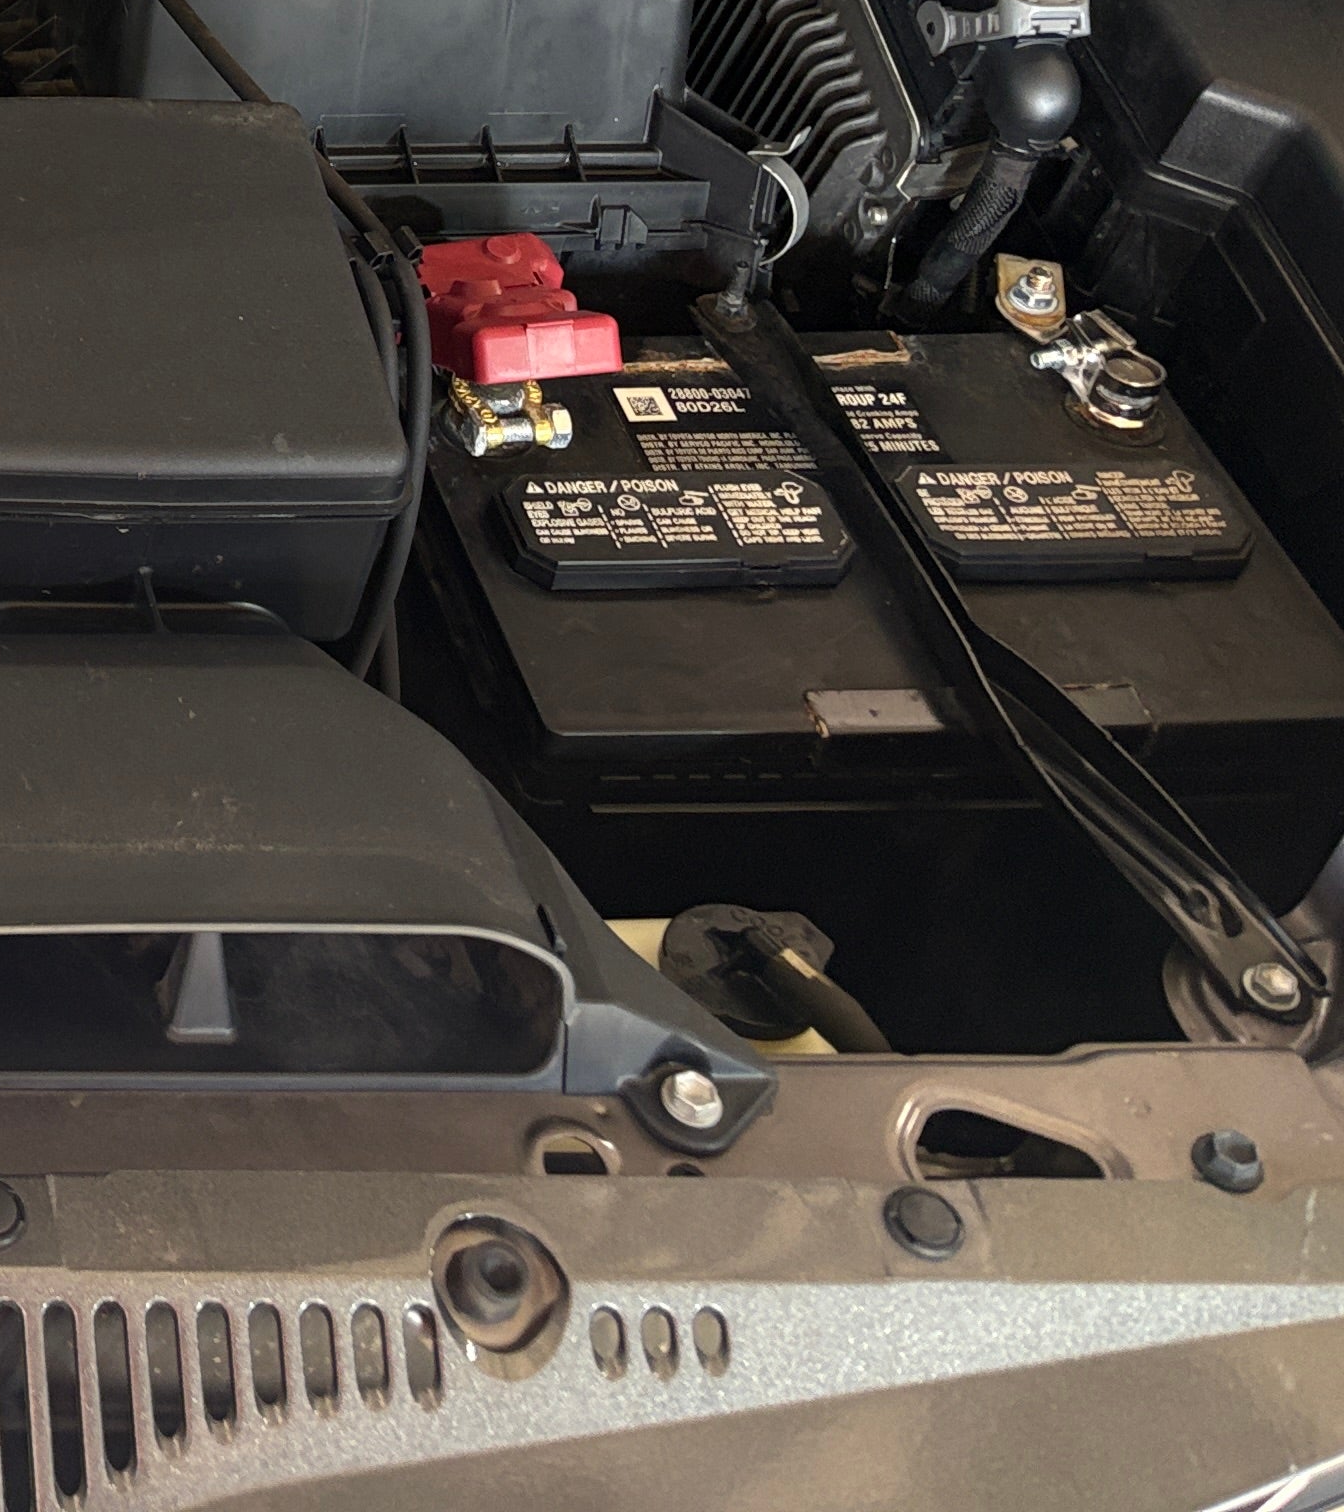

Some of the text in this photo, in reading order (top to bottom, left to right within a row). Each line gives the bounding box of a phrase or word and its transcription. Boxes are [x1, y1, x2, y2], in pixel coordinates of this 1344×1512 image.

[667, 387, 752, 400] 28800-03047
[835, 392, 907, 406] ROUP 24F
[872, 417, 918, 429] AMPS
[879, 439, 940, 452] MINUTES
[935, 472, 1001, 486] DANGER
[1012, 471, 1073, 484] POISON
[544, 480, 607, 494] DANGER
[620, 479, 679, 493] POISON
